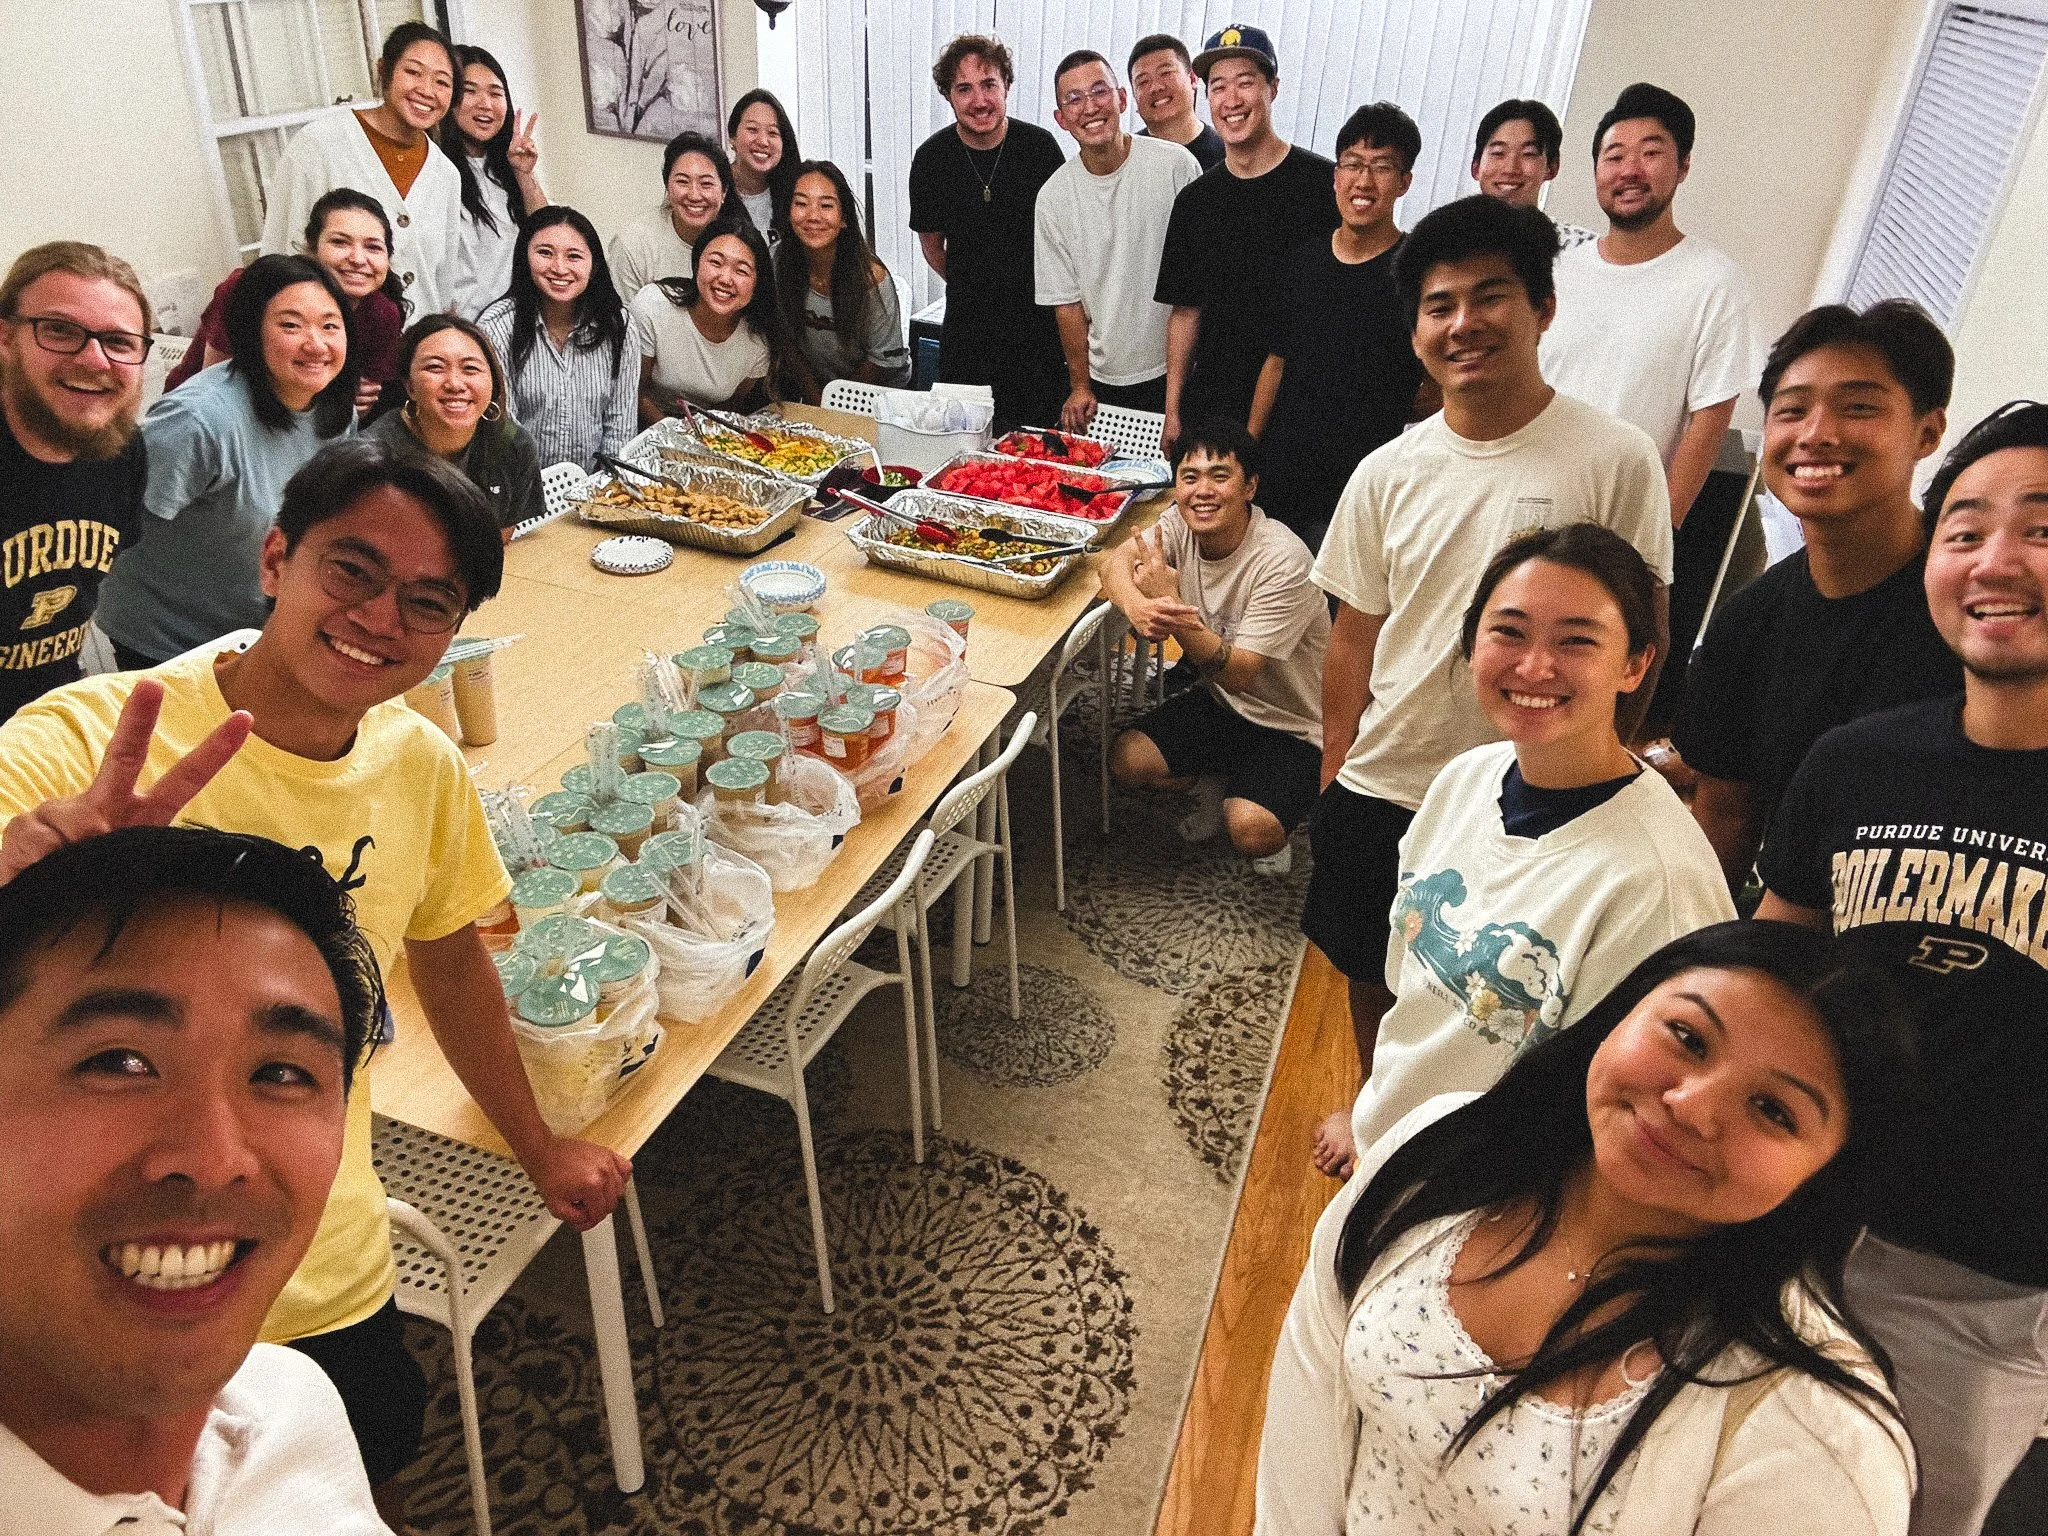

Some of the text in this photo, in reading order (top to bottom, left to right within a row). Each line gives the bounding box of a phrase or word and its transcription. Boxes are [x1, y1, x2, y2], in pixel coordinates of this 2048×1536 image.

[667, 8, 712, 41] love
[2, 519, 120, 589] URDUE
[20, 585, 78, 630] P
[0, 620, 91, 670] GINEERI
[1855, 824, 2048, 862] PURDUE UNIVER
[1908, 935, 1989, 974] P
